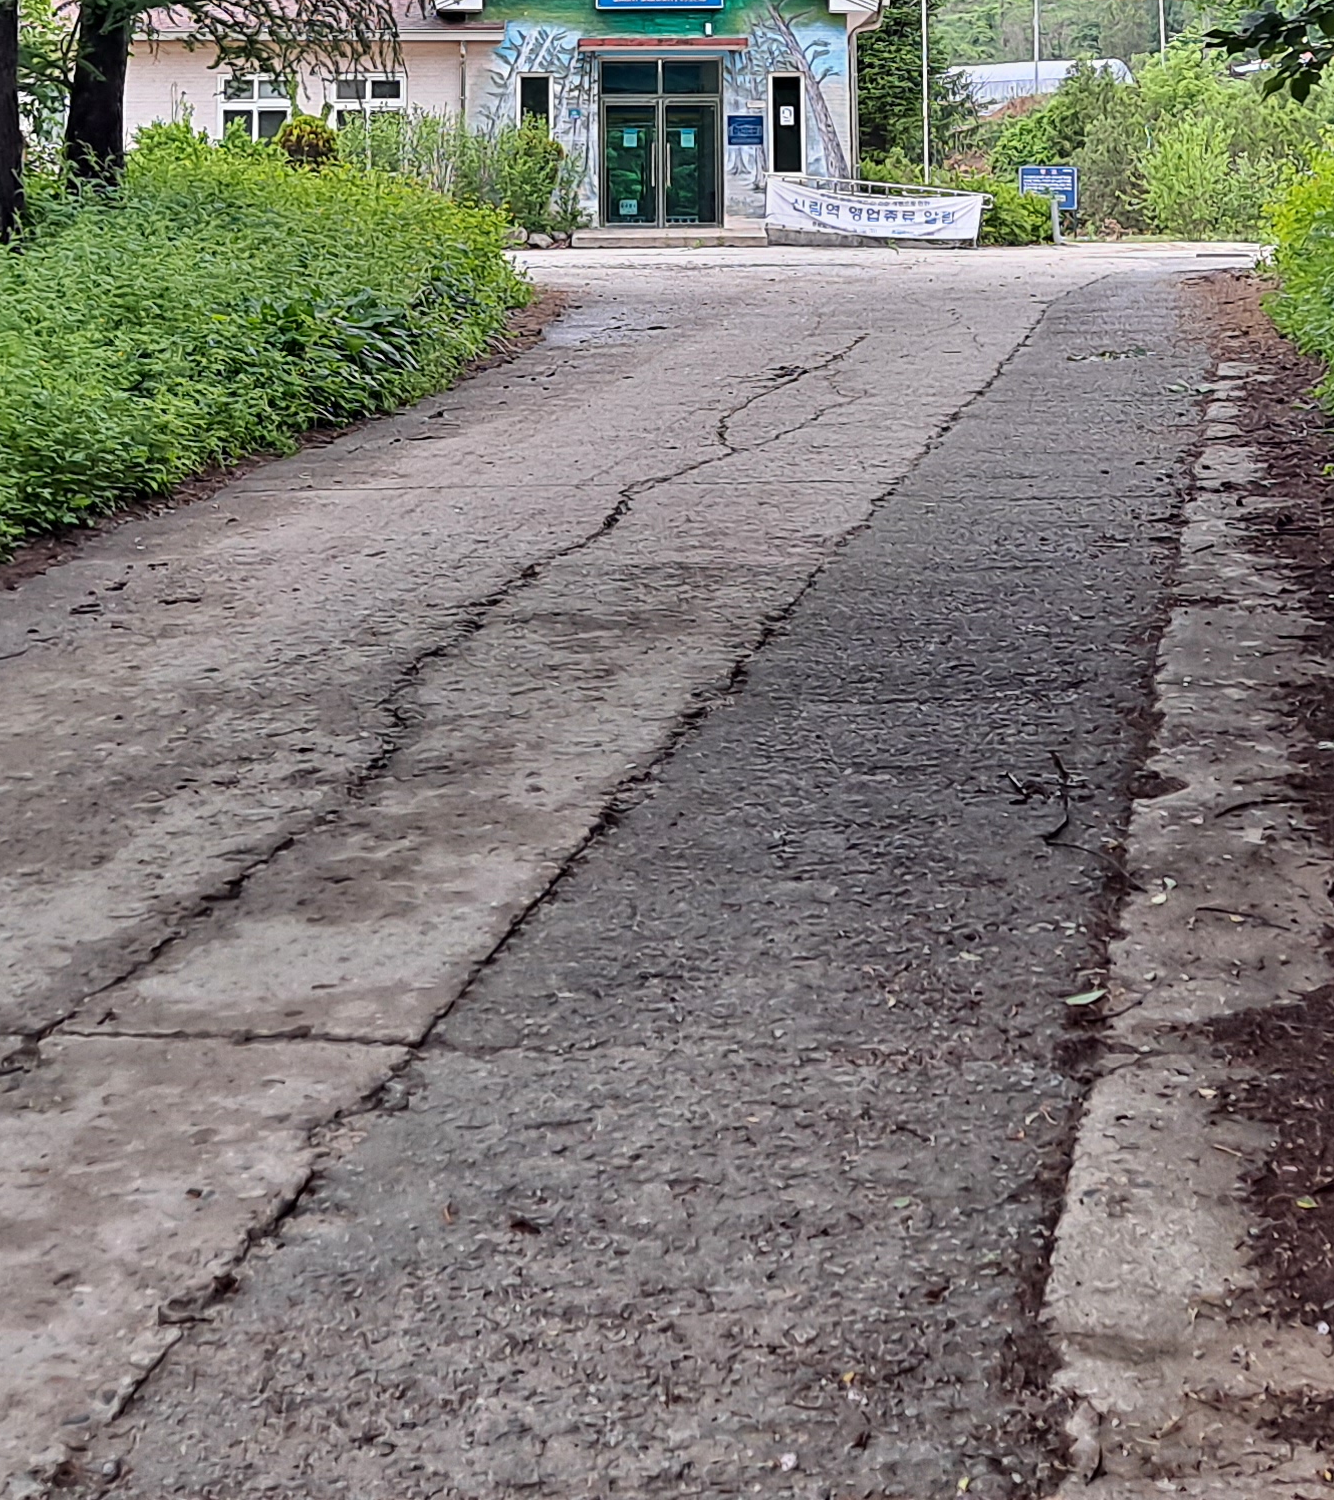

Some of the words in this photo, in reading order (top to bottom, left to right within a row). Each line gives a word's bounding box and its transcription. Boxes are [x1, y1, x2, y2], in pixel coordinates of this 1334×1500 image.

[791, 198, 840, 219] 신림역
[848, 206, 915, 222] 영업종료
[924, 210, 955, 224] 알림
